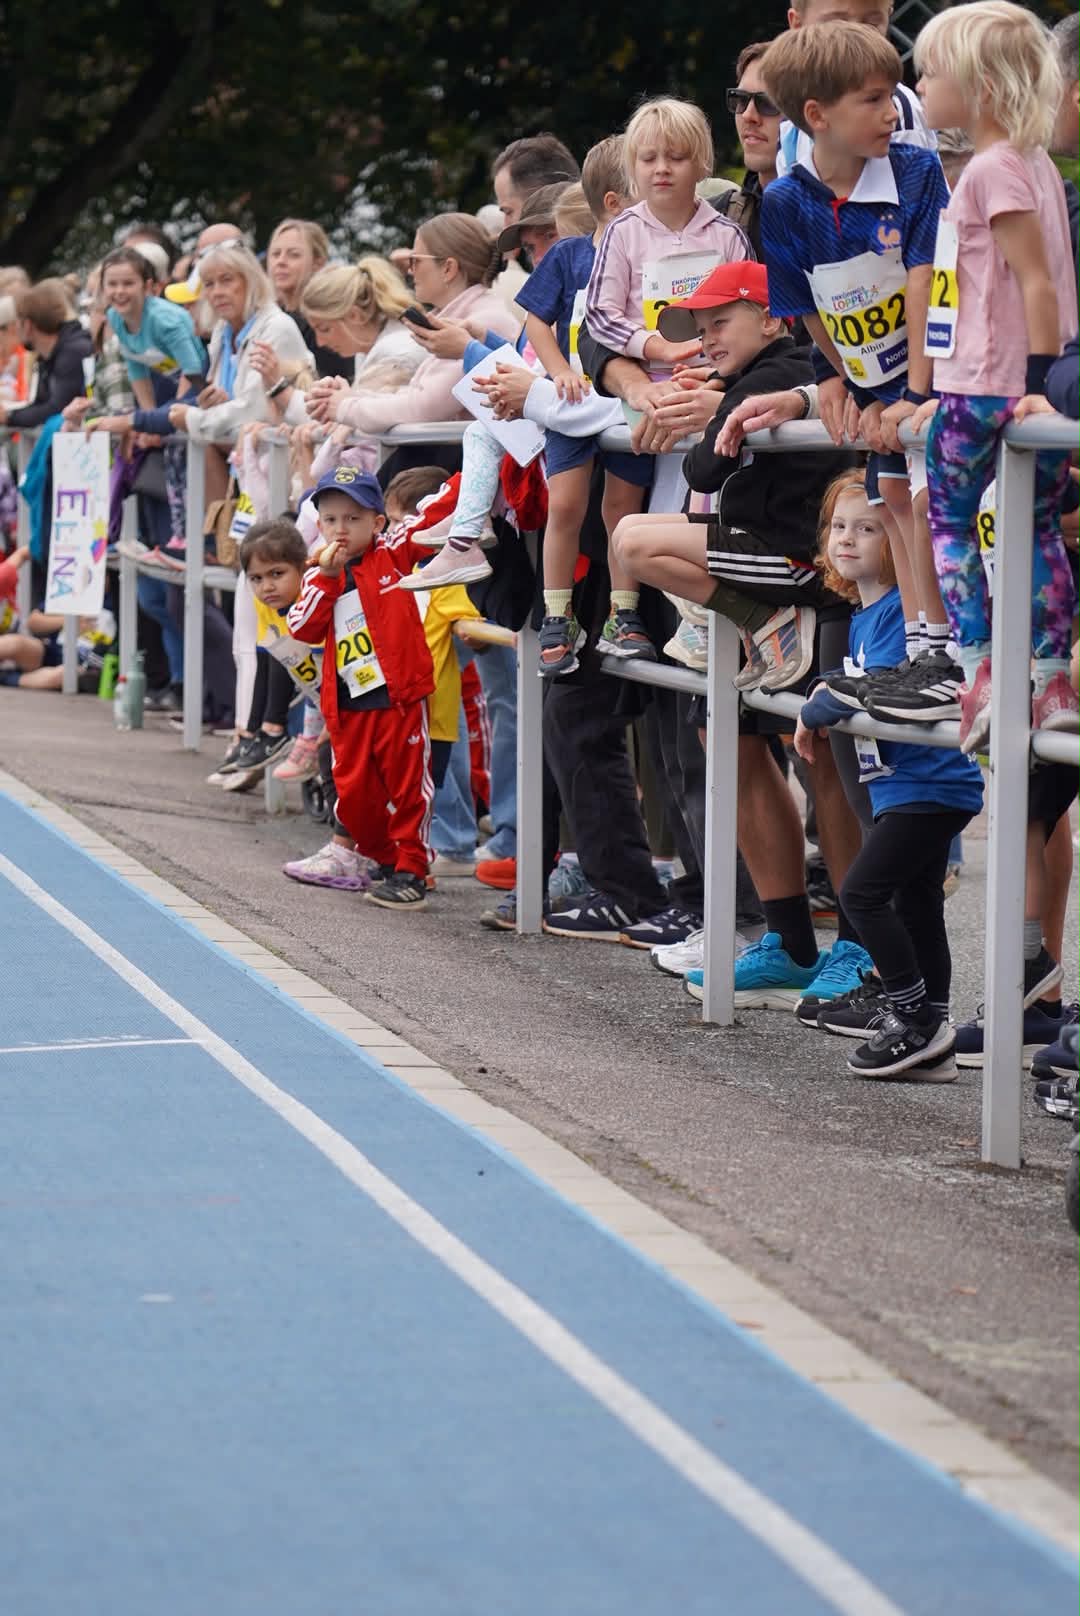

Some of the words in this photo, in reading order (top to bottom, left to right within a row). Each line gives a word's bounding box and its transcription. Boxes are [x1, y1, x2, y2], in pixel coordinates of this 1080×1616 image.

[827, 292, 907, 347] 2082
[860, 341, 886, 356] Albin
[49, 488, 88, 600] ELINA
[338, 631, 373, 666] 20
